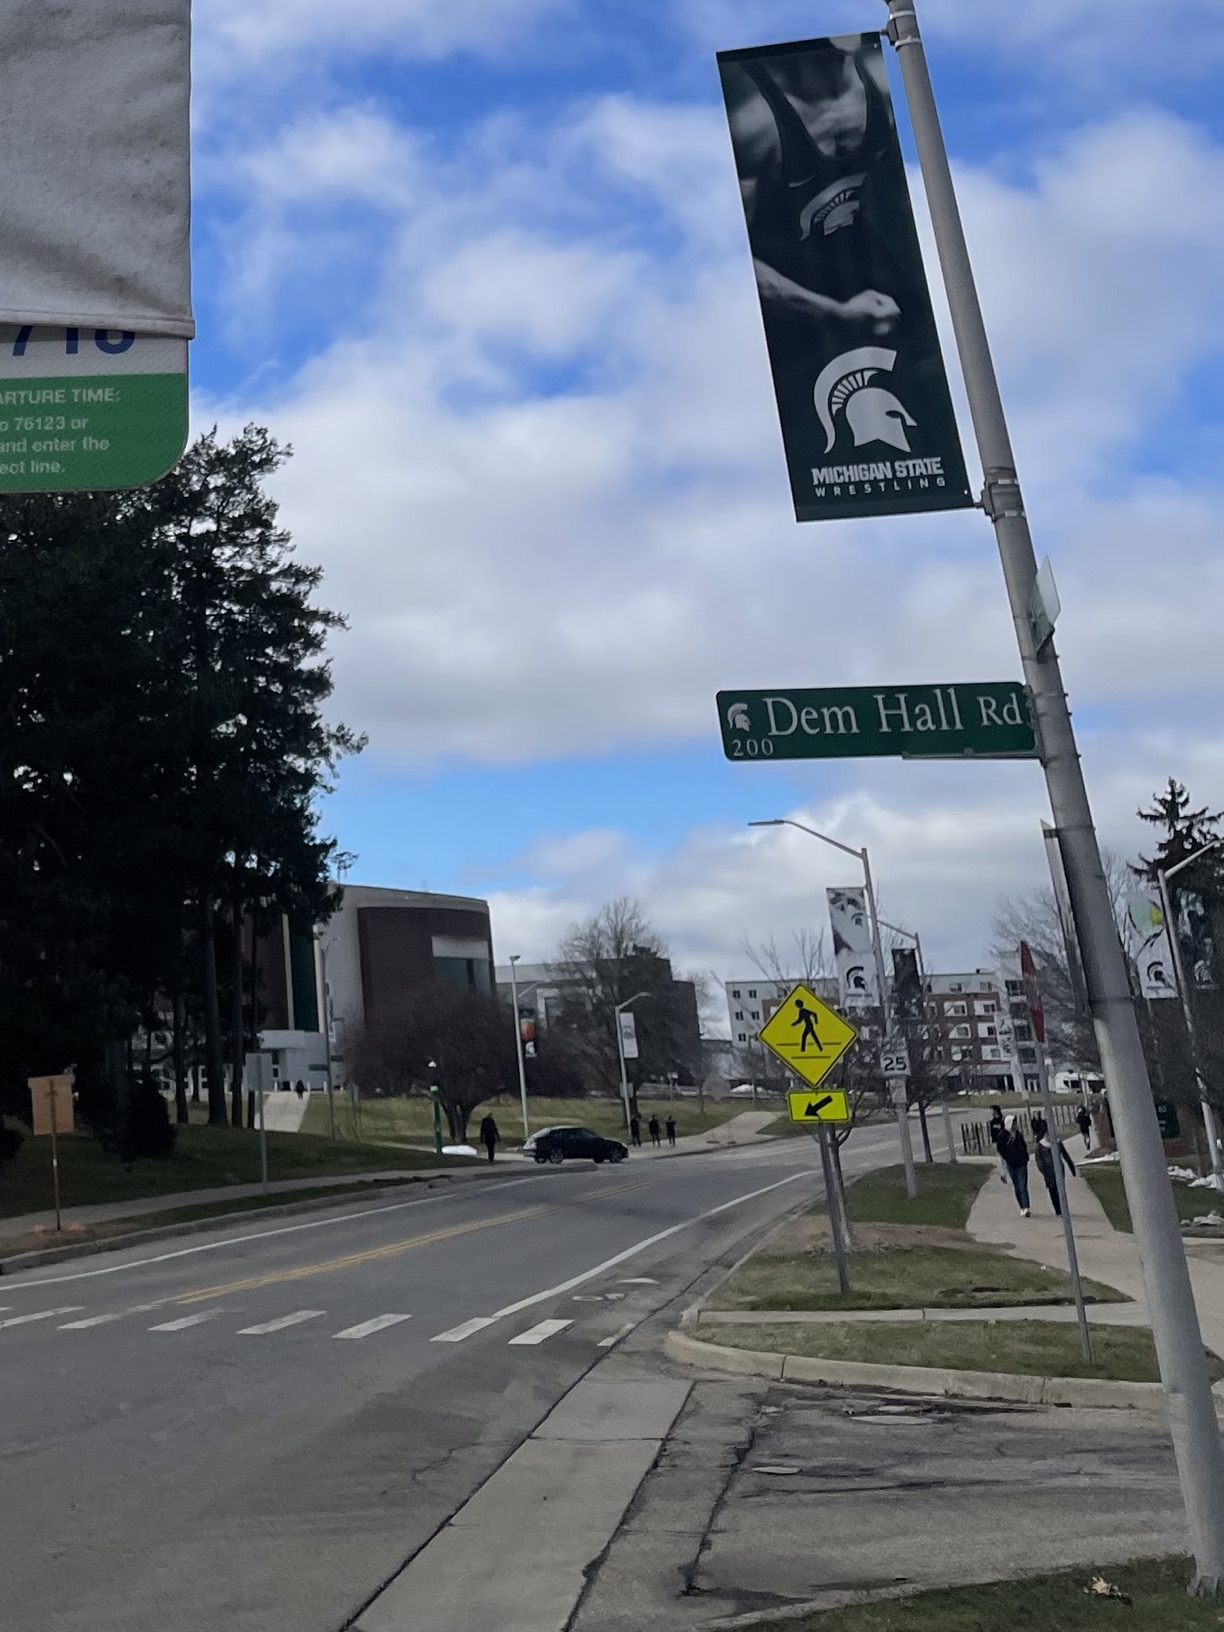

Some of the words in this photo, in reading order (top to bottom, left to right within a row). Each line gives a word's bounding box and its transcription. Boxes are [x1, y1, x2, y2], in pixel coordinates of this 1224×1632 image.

[71, 417, 89, 430] or
[32, 437, 76, 453] enter
[81, 435, 111, 451] the
[31, 459, 66, 474] line.
[811, 461, 893, 485] MICHIGAN
[894, 456, 945, 478] STATE
[815, 477, 946, 497] WRESTLING
[761, 696, 861, 737] Dem
[873, 686, 964, 735] Hall
[976, 692, 1024, 727] Rd
[730, 737, 774, 758] 200
[882, 1055, 908, 1072] 25
